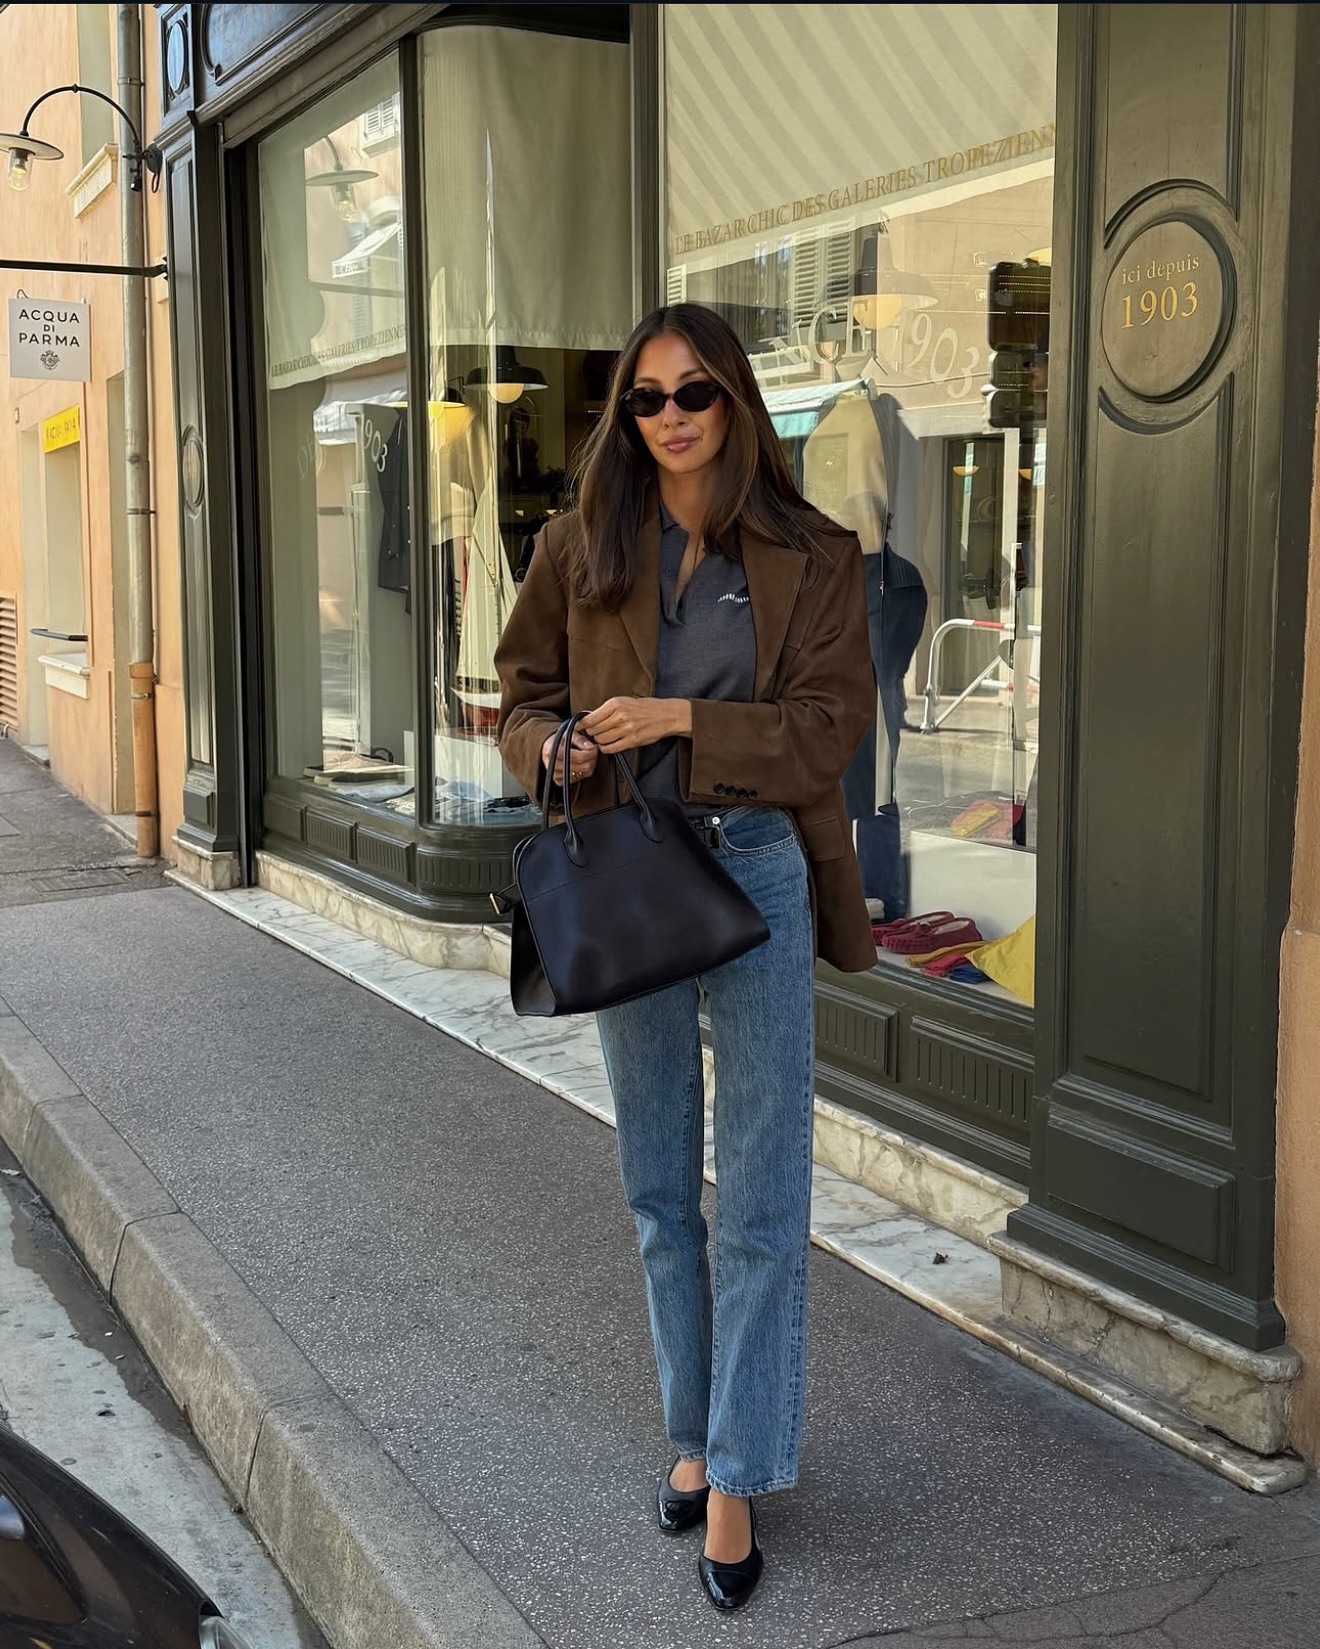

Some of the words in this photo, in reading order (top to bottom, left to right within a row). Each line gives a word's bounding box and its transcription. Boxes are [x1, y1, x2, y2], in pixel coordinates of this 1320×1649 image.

[695, 219, 744, 249] BAZAR
[747, 204, 789, 234] CHIC
[792, 194, 824, 222] DES
[828, 166, 918, 210] GALERIES
[1122, 265, 1141, 284] ici
[1146, 253, 1199, 280] depuis
[18, 309, 80, 324] ACQUA
[1121, 282, 1198, 329] 1903
[18, 333, 80, 348] PARMA
